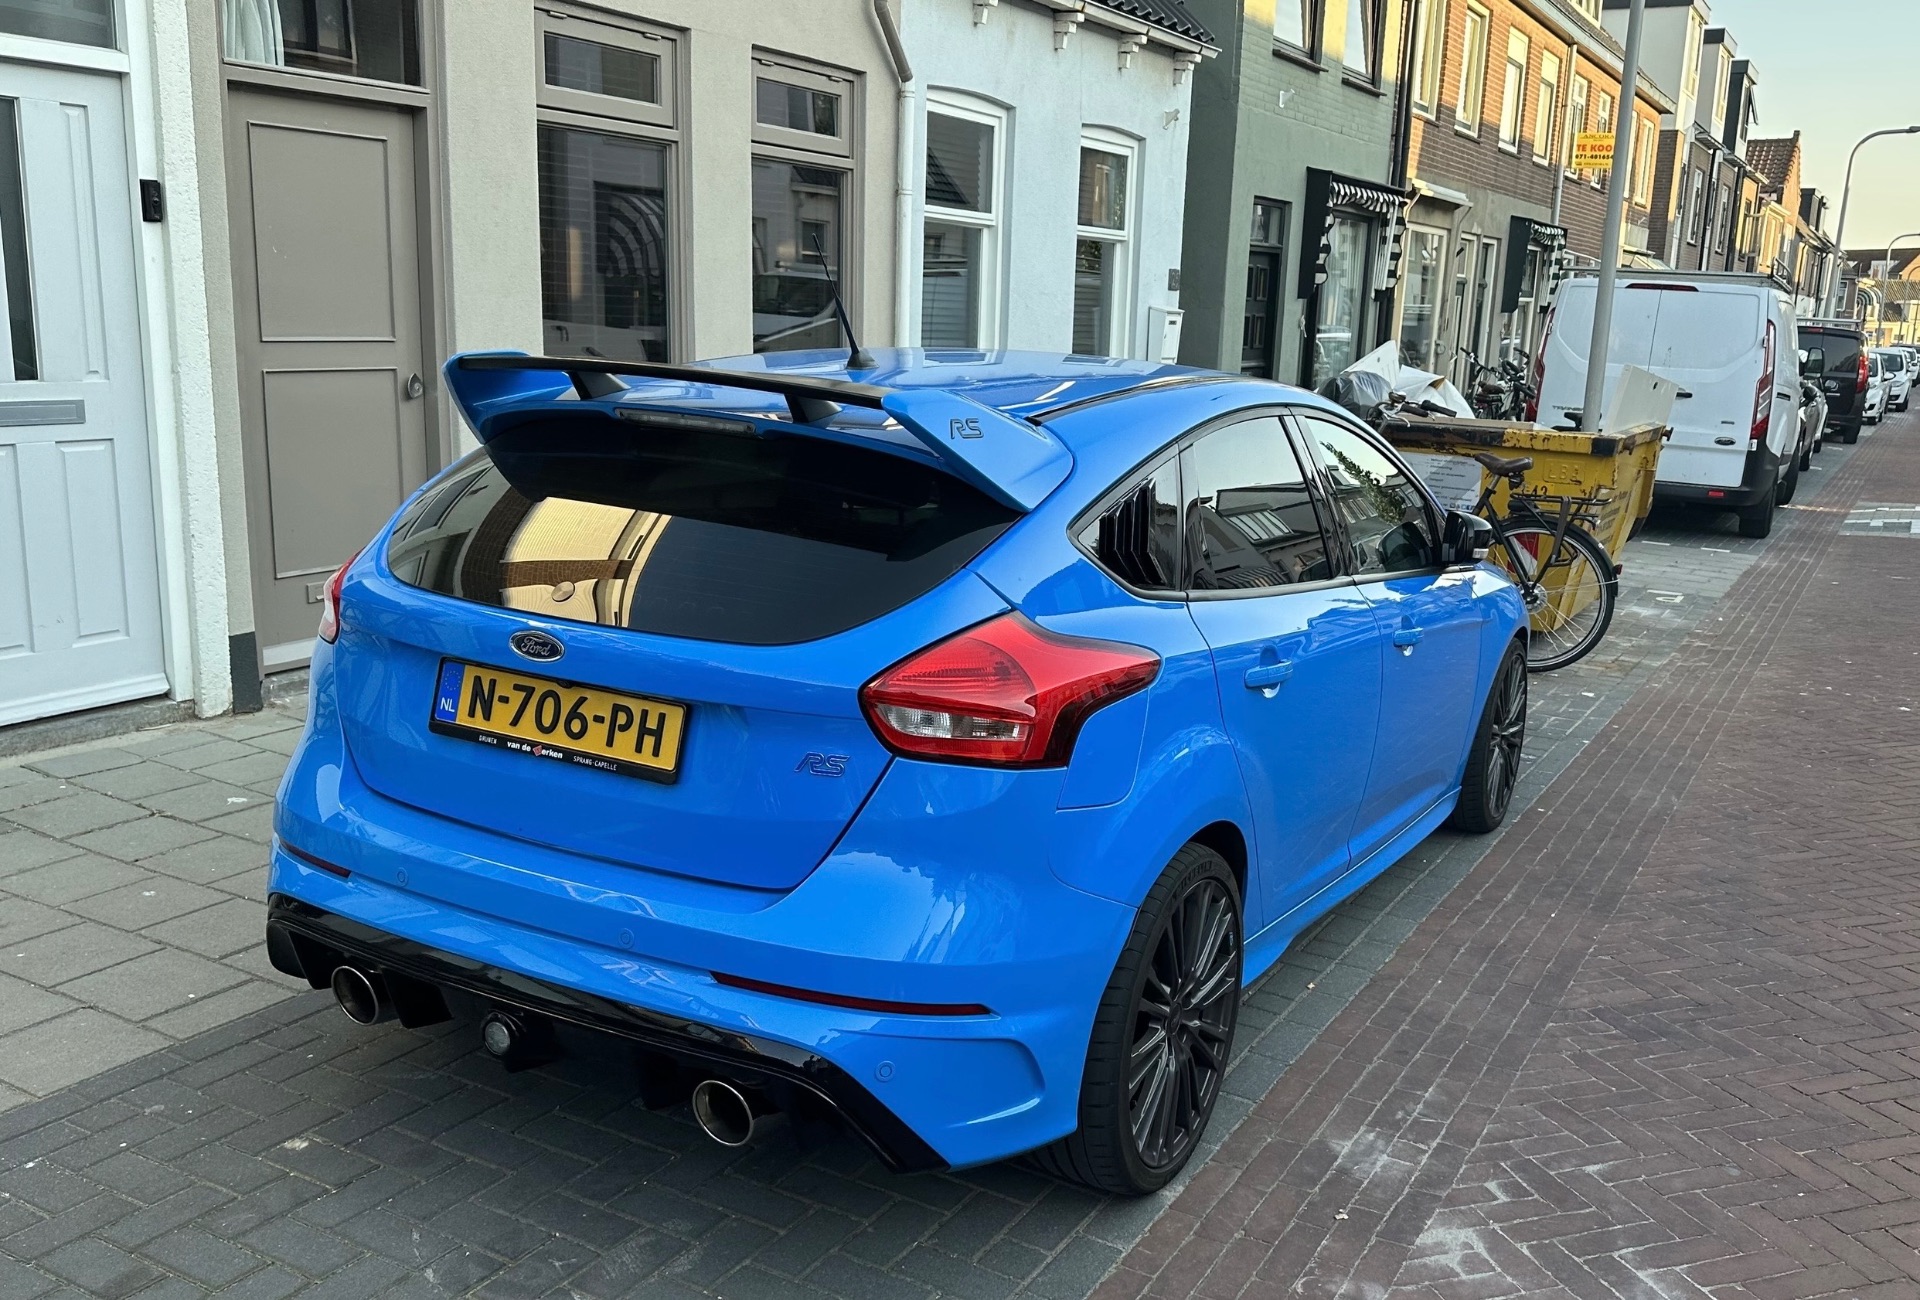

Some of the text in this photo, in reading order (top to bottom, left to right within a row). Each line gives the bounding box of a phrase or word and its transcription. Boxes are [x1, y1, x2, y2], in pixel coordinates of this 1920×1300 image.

[1576, 144, 1613, 152] TE KOO
[950, 418, 984, 439] RS
[521, 636, 551, 656] Ford
[440, 697, 455, 713] NL
[467, 675, 667, 758] N-706-PH
[507, 741, 521, 750] van
[521, 743, 532, 752] de
[794, 752, 851, 777] RS
